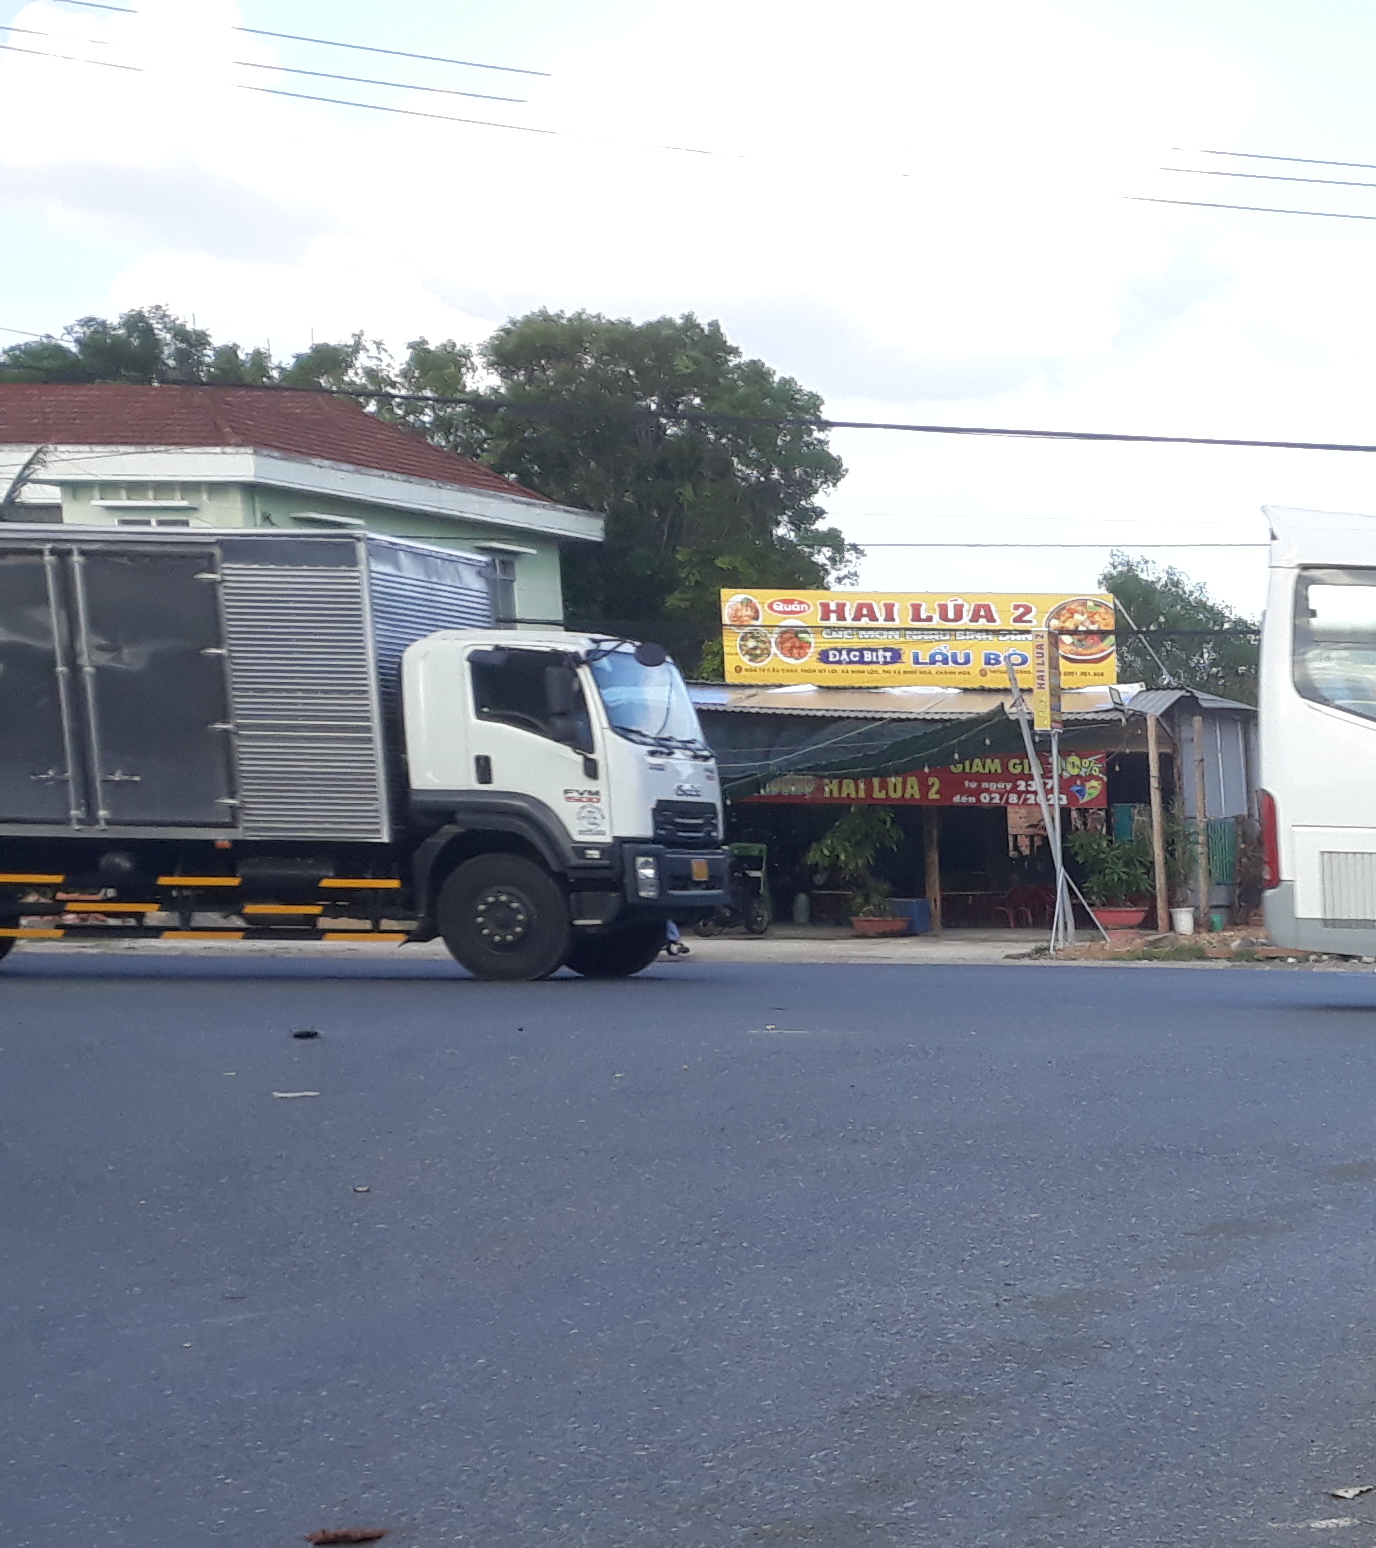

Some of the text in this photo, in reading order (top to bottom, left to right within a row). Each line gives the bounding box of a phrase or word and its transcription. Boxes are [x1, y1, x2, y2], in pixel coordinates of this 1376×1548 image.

[772, 599, 1034, 624] Quán HAI LÚA 2
[828, 649, 859, 665] ĐẶC
[863, 649, 893, 665] BIỆT
[1036, 670, 1046, 690] HAI
[824, 778, 866, 798] HAI
[928, 777, 941, 799] 2
